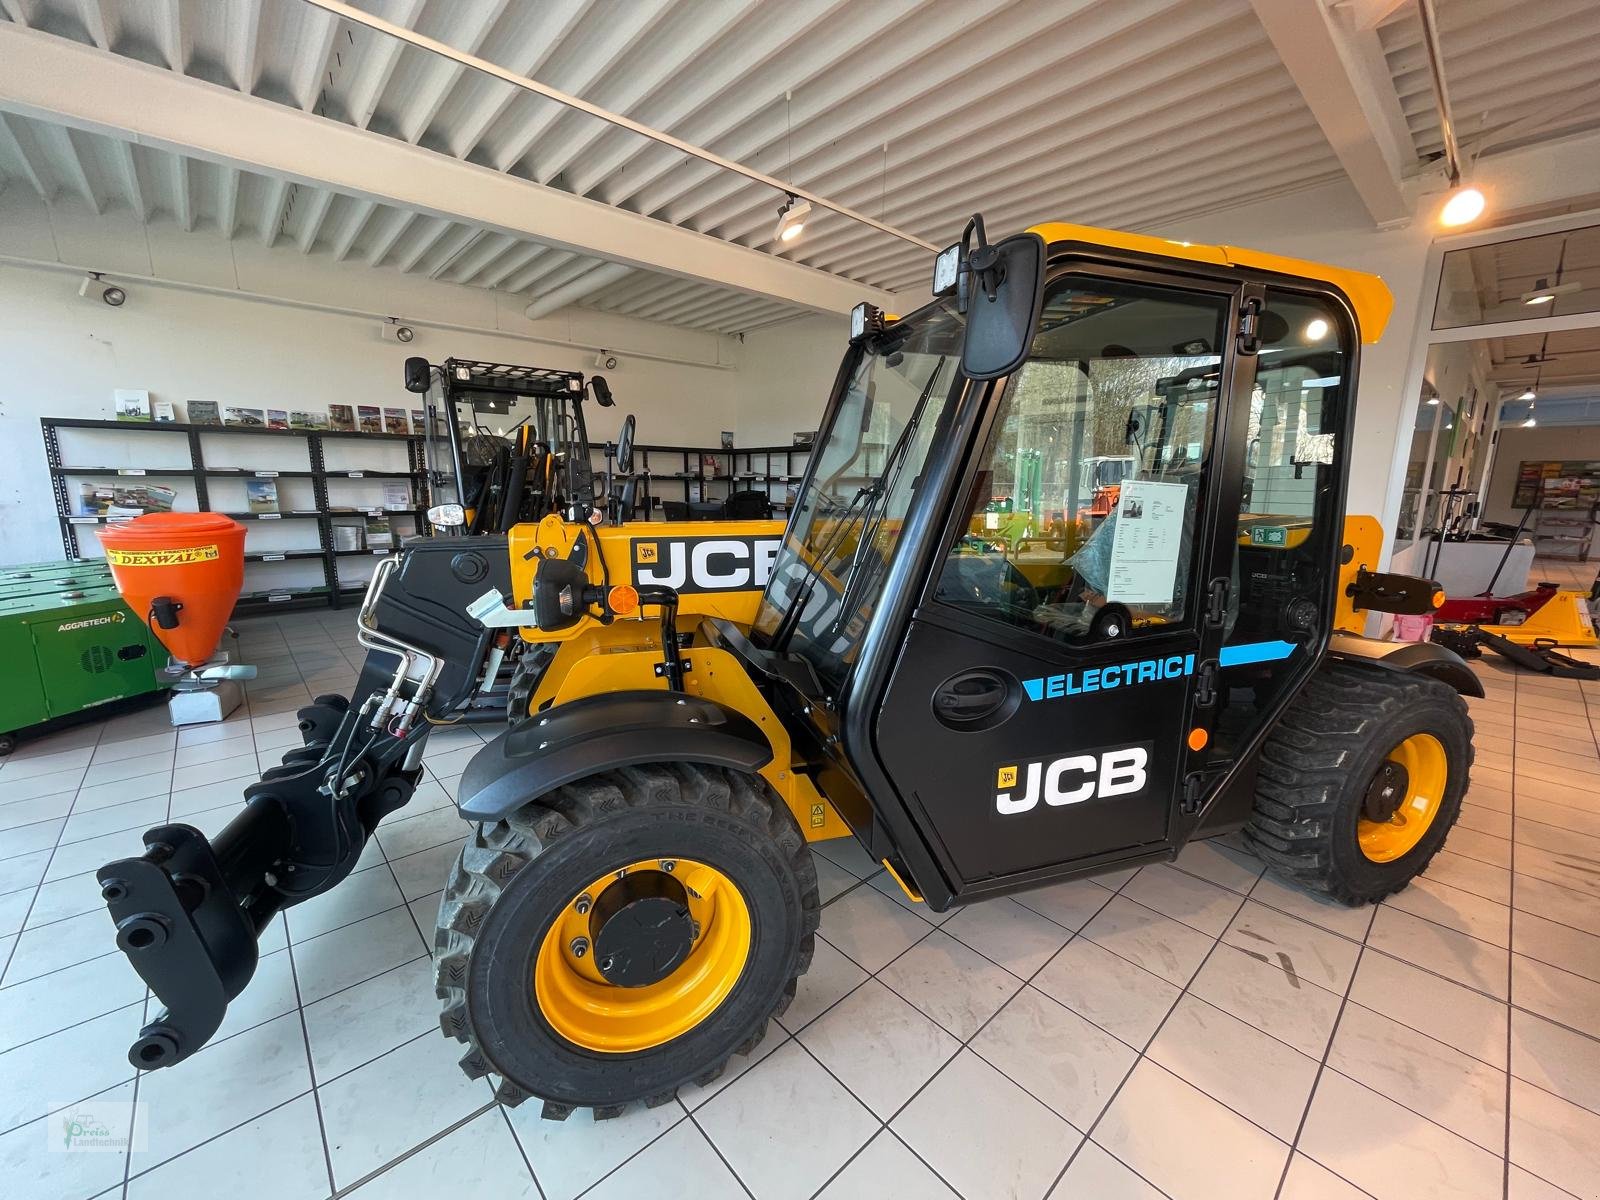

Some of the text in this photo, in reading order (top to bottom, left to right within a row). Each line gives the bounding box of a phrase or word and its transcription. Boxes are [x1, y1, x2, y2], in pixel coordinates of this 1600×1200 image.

[58, 616, 111, 632] AGGRETECH
[1046, 656, 1184, 698] ELECTRIC
[996, 748, 1148, 814] JCB
